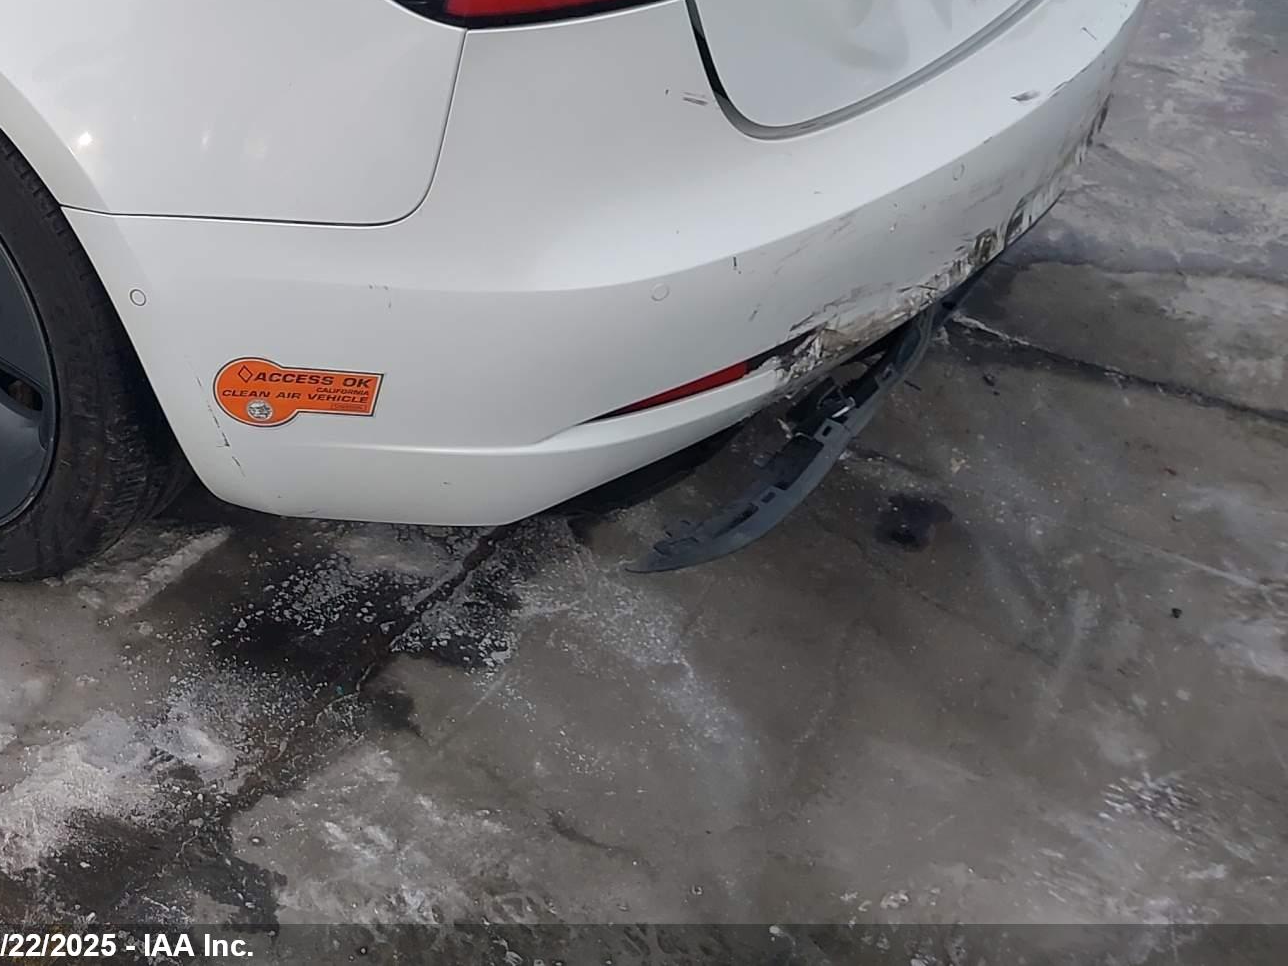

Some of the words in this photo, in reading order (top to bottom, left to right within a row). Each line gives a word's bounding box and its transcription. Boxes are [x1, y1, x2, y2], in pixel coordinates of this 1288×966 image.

[253, 372, 334, 386] ACCESS
[342, 377, 373, 388] OK
[222, 389, 271, 398] CLEAN
[276, 391, 302, 400] AIR
[308, 393, 369, 404] VEHICLE
[316, 387, 369, 396] CALIFORNIA
